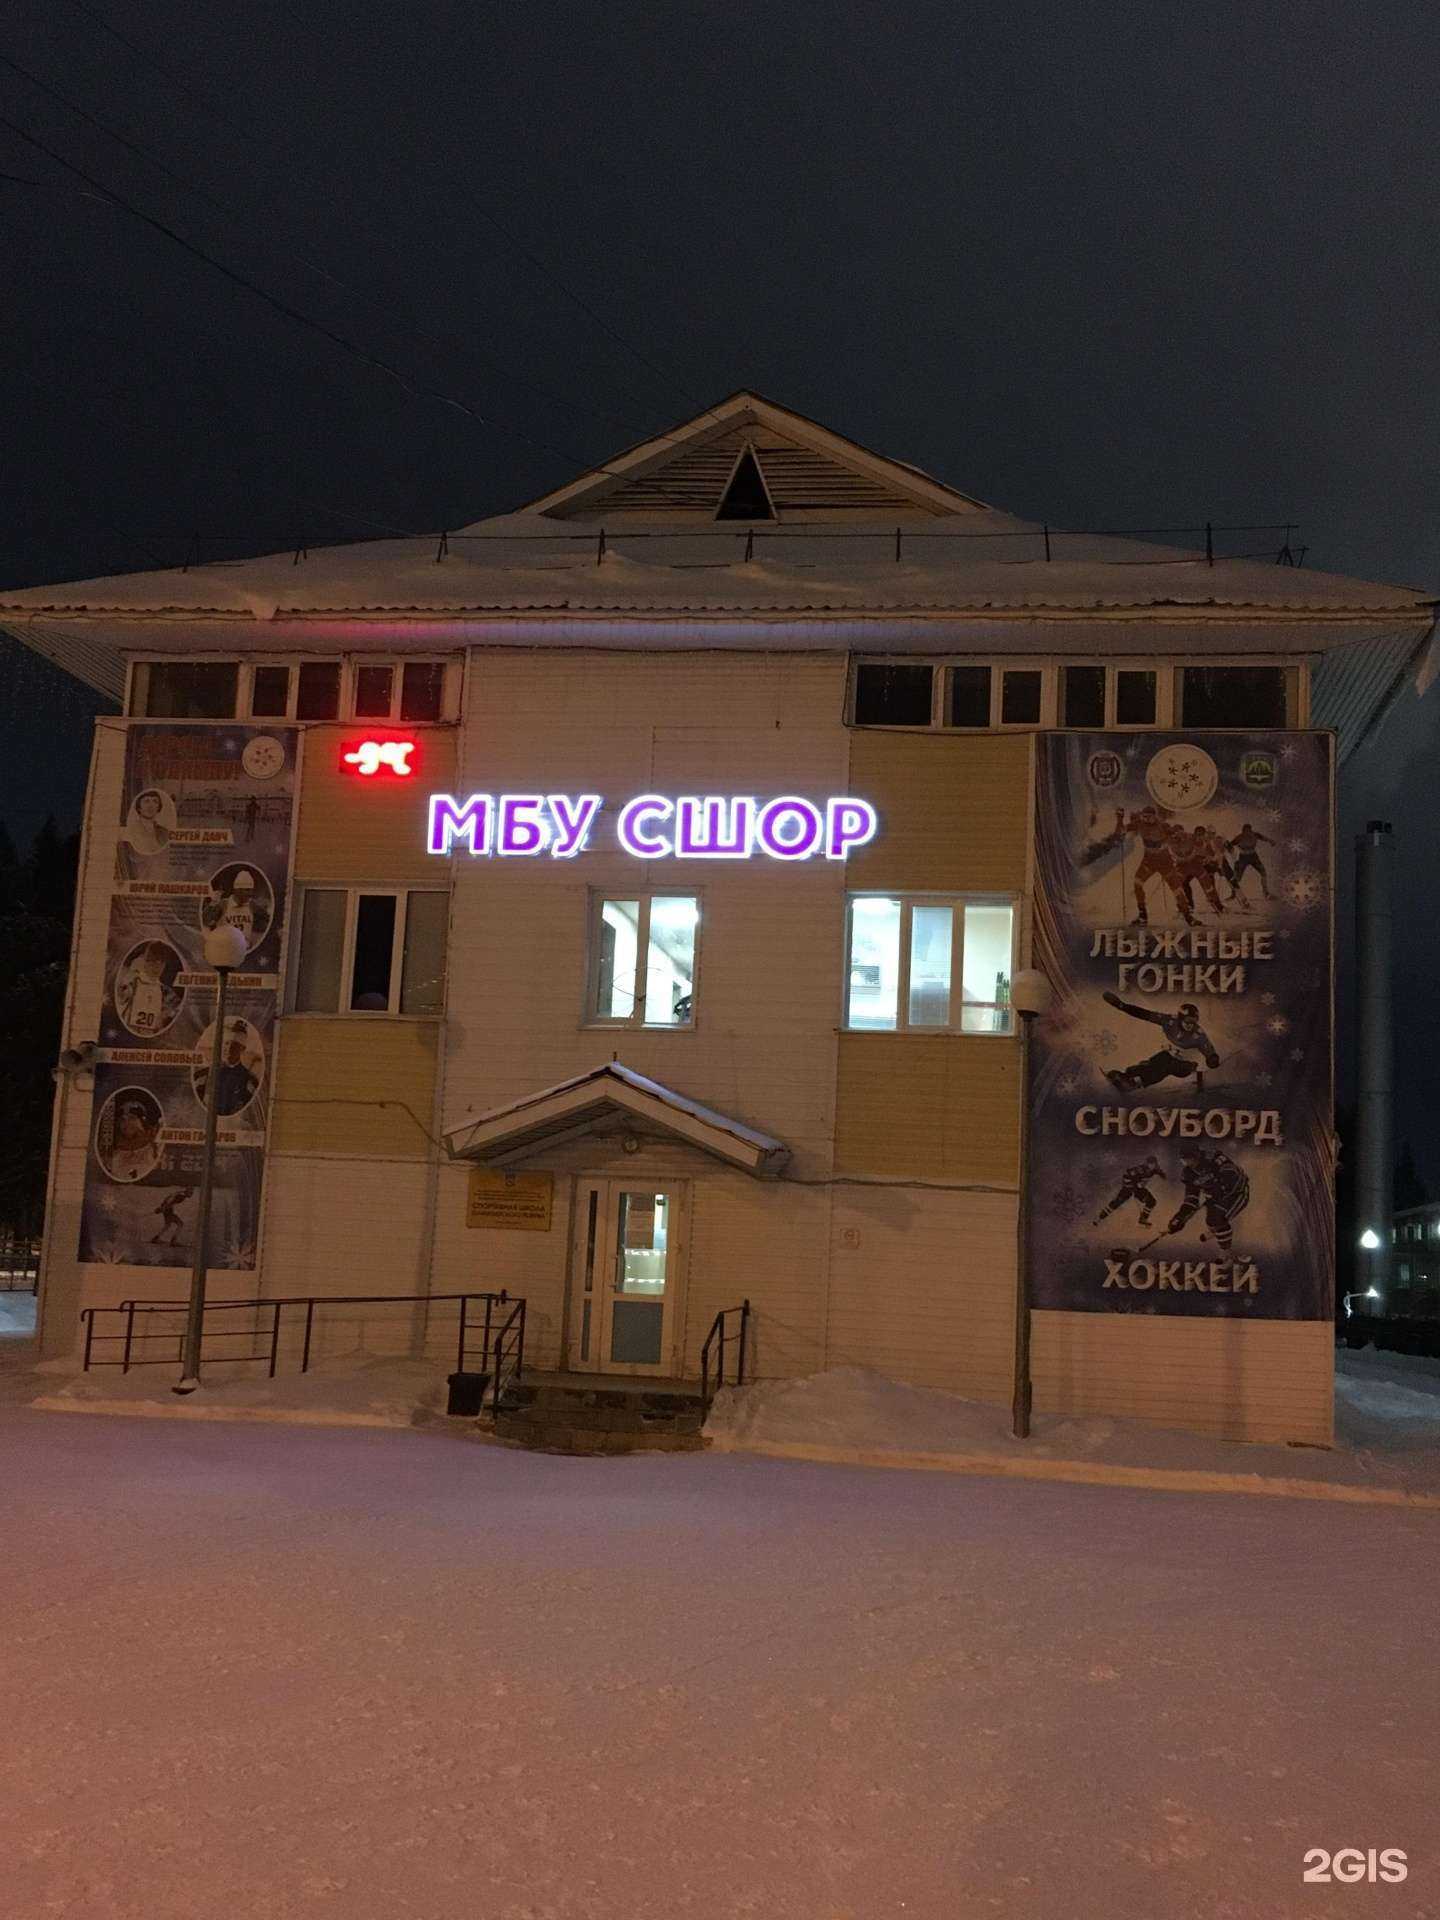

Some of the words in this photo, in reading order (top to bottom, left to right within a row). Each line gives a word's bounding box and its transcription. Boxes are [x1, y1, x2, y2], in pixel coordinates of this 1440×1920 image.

[428, 794, 600, 858] МБУ
[617, 795, 877, 861] СШОР
[1089, 929, 1276, 960] ЛЫЖНЫЕ
[1118, 962, 1248, 994] ГОНКИ
[136, 1011, 154, 1026] 20
[1075, 1105, 1285, 1147] СНОУБОРД
[1102, 1255, 1262, 1297] ХОККЕЙ
